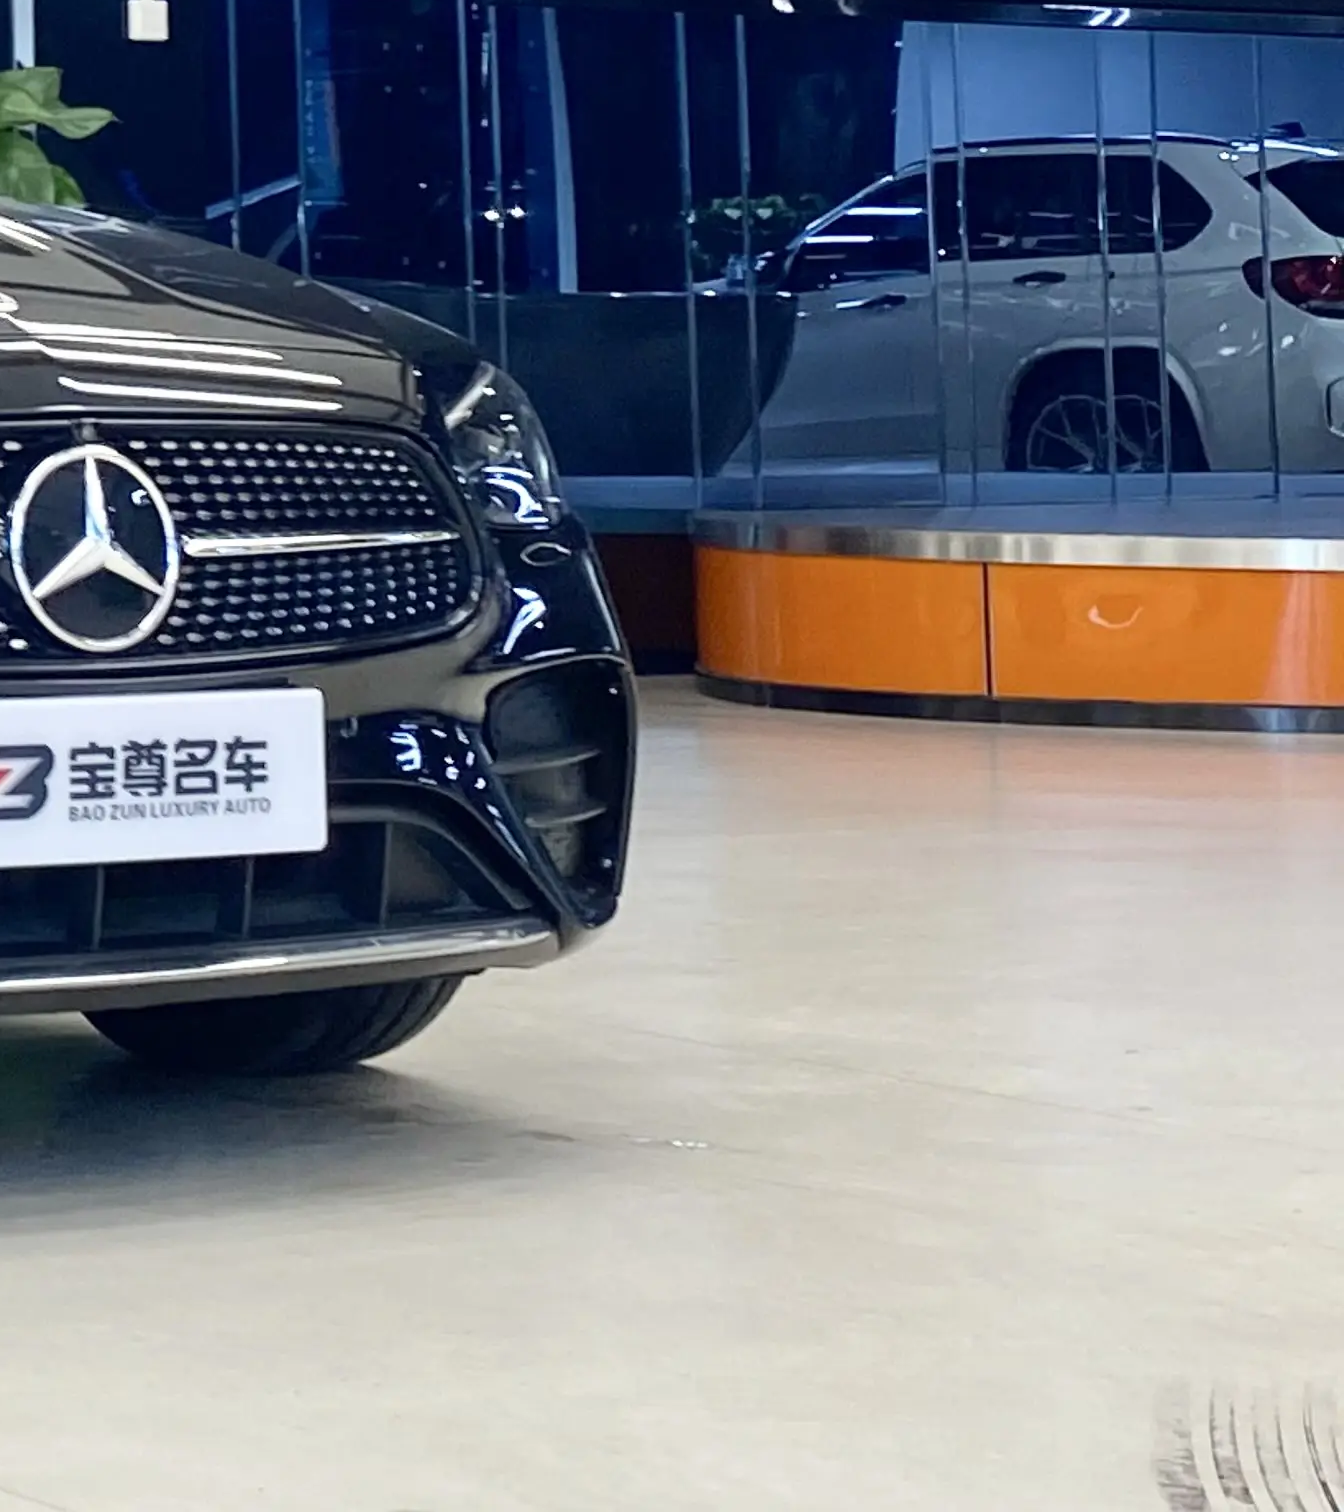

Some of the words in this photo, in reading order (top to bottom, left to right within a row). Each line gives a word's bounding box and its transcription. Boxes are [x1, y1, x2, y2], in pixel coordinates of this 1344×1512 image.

[69, 736, 268, 800] 宝尊名车
[68, 805, 106, 822] BAO
[110, 803, 147, 821] ZUN
[150, 800, 220, 819] LUXURY
[223, 797, 272, 815] AUTO
